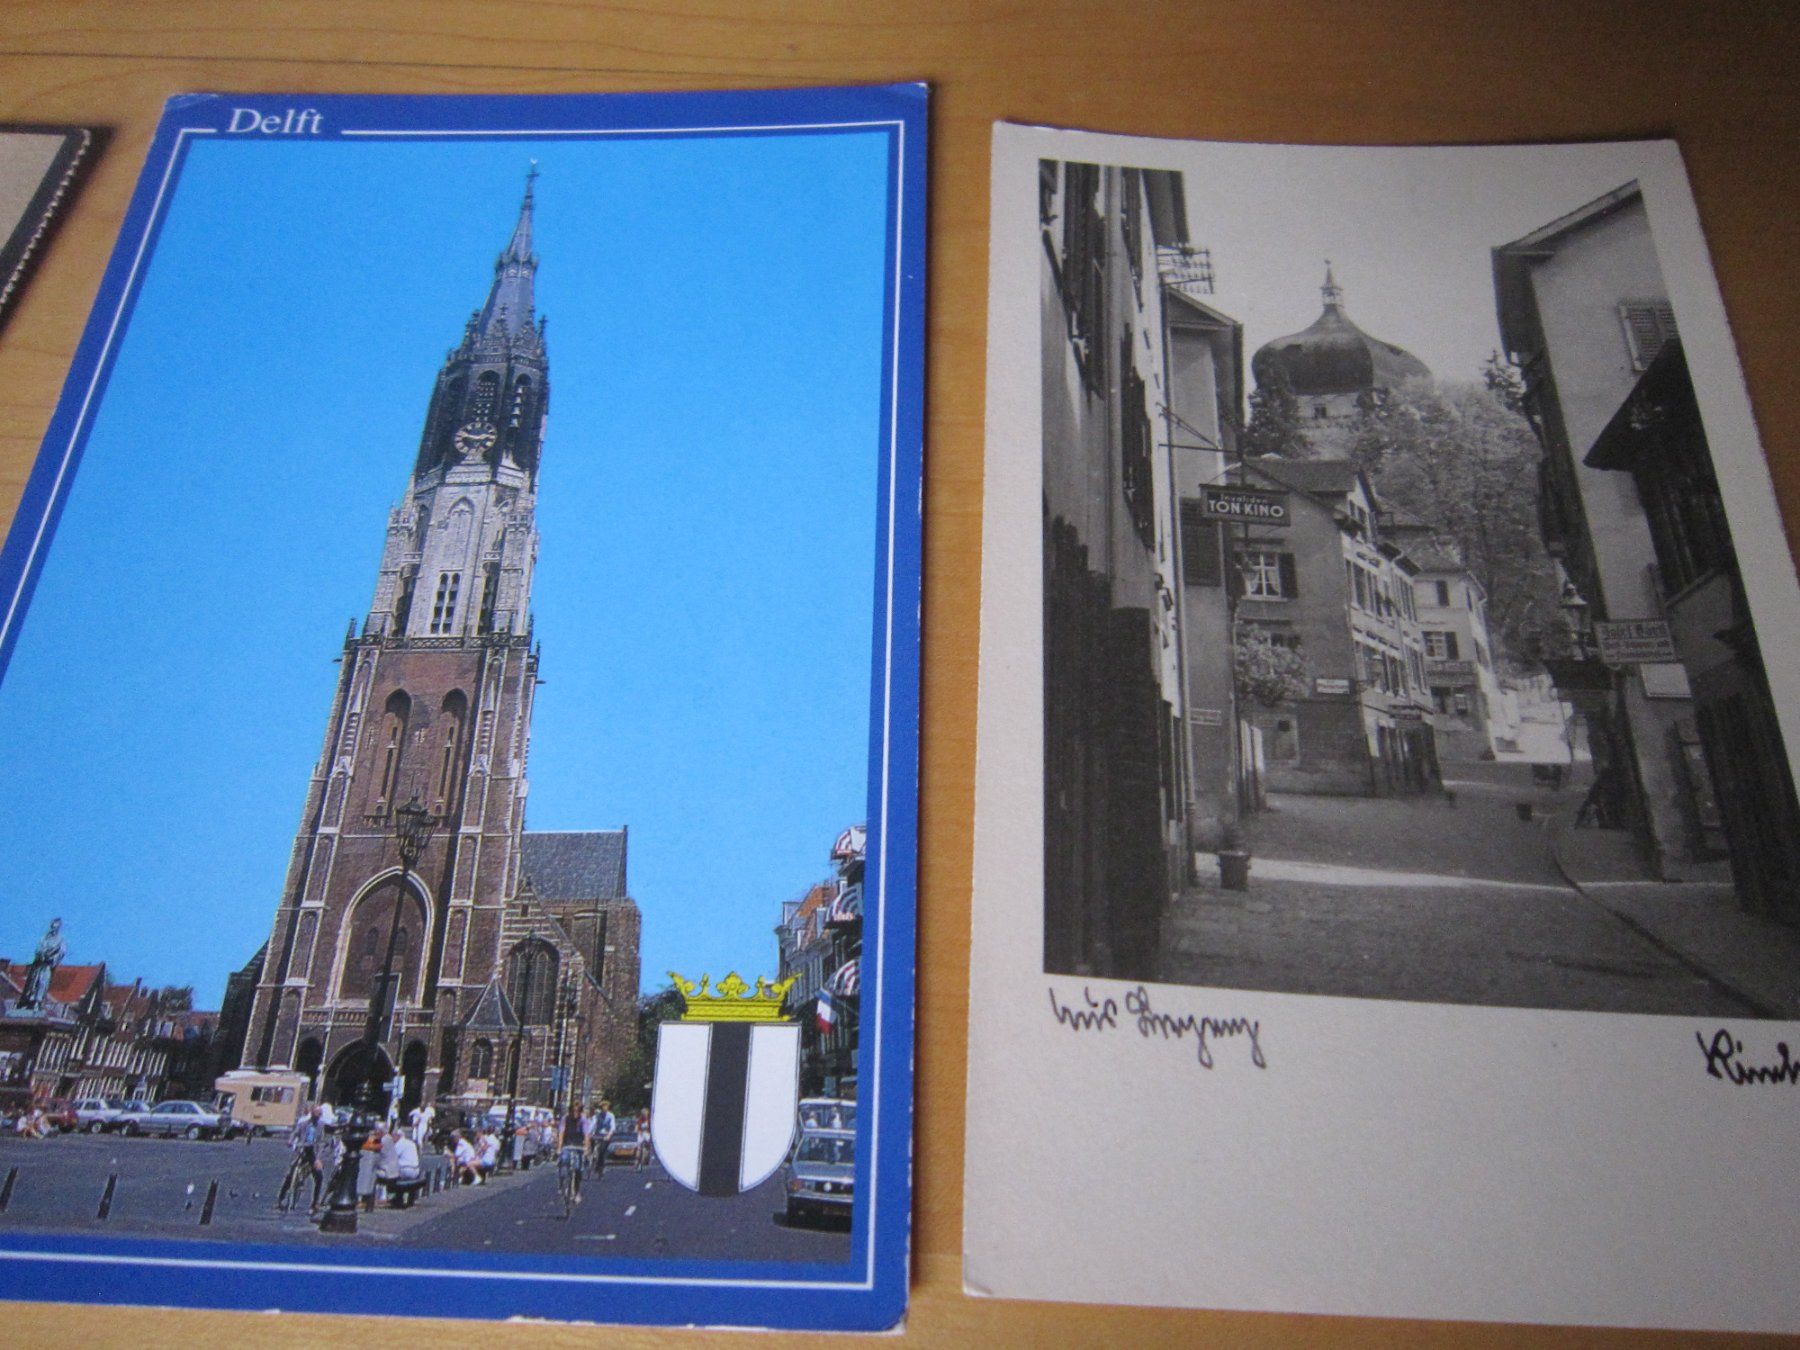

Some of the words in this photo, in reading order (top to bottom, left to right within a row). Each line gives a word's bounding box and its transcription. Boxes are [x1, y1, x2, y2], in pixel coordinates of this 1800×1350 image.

[225, 107, 324, 134] Delft
[1208, 499, 1241, 514] TON
[1244, 503, 1285, 518] KINO
